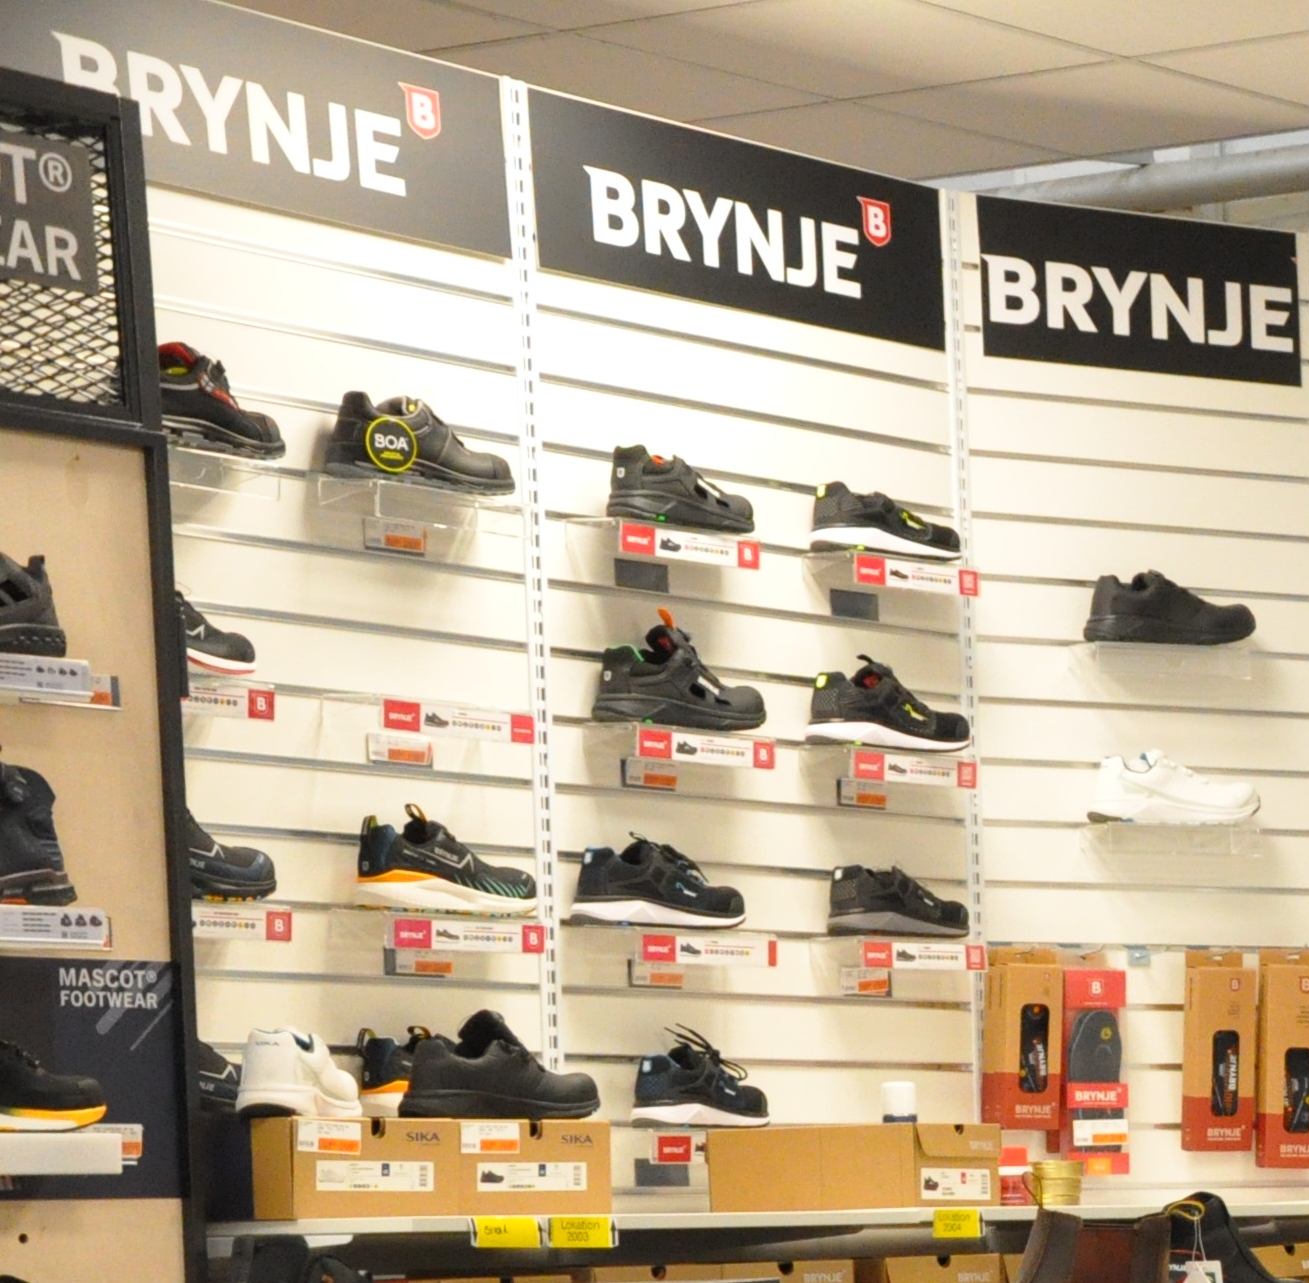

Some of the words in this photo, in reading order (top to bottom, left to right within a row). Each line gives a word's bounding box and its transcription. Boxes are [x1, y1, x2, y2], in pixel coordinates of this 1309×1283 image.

[51, 31, 406, 197] BRYNJE
[583, 165, 861, 299] BRYNJE
[981, 254, 1294, 353] BRYNJE
[374, 433, 409, 451] BOA
[60, 990, 158, 1009] FOOTWEAR
[1228, 1054, 1237, 1091] BRYNJE
[1075, 1090, 1117, 1102] BRYNJE
[1015, 1104, 1051, 1114] BRYNJE
[406, 1132, 440, 1142] SIKA
[1207, 1128, 1241, 1137] BRYNJE
[561, 1134, 592, 1144] SIKA
[938, 1213, 971, 1223] Lokation
[561, 1220, 600, 1230] Lokation
[943, 1223, 962, 1232] 2004
[567, 1232, 590, 1242] 2003
[804, 1272, 843, 1283] BRYNJE
[957, 1272, 991, 1283] BRYNJE
